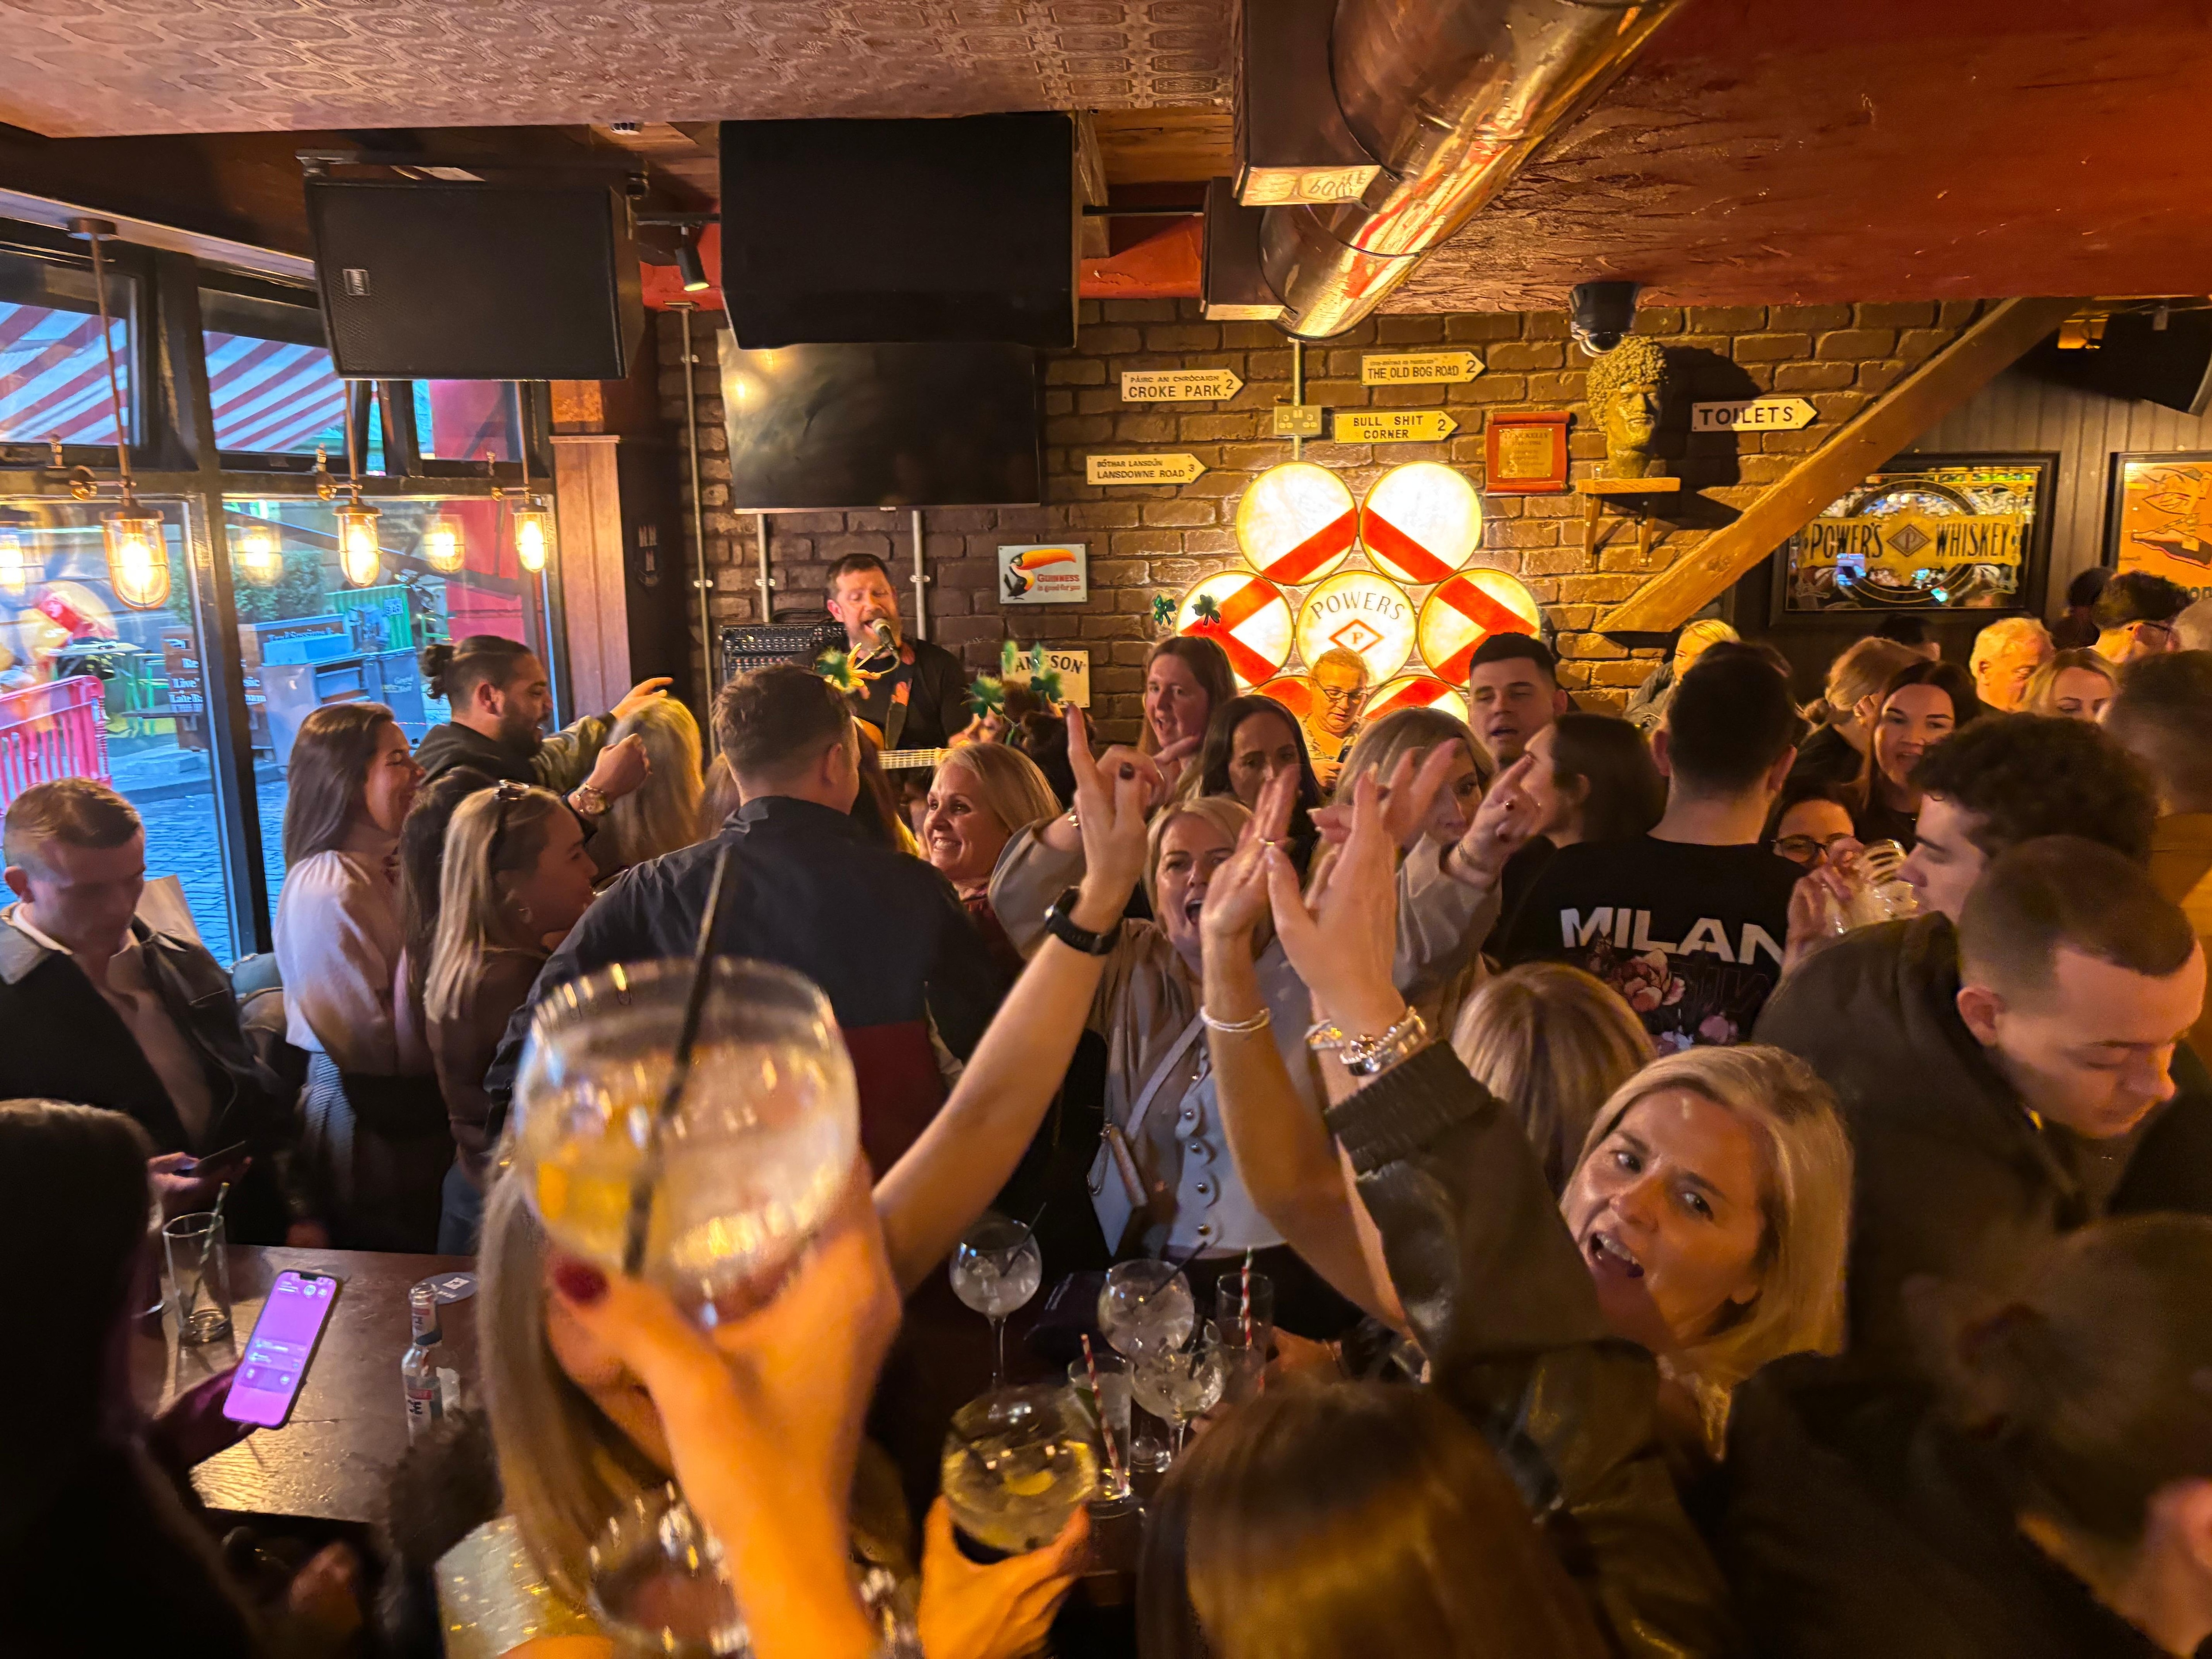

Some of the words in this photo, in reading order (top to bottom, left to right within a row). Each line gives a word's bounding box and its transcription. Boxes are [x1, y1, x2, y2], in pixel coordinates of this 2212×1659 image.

[1367, 368, 1387, 379] THE
[1390, 367, 1409, 378] OLD
[1413, 366, 1432, 377] BOG
[1435, 365, 1459, 376] ROAD
[1466, 359, 1476, 373] 2
[1129, 386, 1176, 398] CROKE
[1185, 384, 1222, 397] PARK
[1225, 379, 1234, 390] 2
[1353, 417, 1382, 426] BULL
[1394, 415, 1424, 426] SHIT
[1698, 406, 1794, 425] TOILETS
[1437, 419, 1447, 431] 2
[1363, 430, 1409, 439] CORNER
[1097, 470, 1156, 479] LANSDOWNE
[1159, 469, 1185, 478] ROAD
[1188, 464, 1195, 472] 3
[1809, 522, 1884, 560] POWER'S
[1935, 523, 2011, 557] WHISKEY
[1310, 592, 1406, 620] POWERS
[1352, 632, 1364, 644] P
[1560, 906, 1783, 966] MILAN
